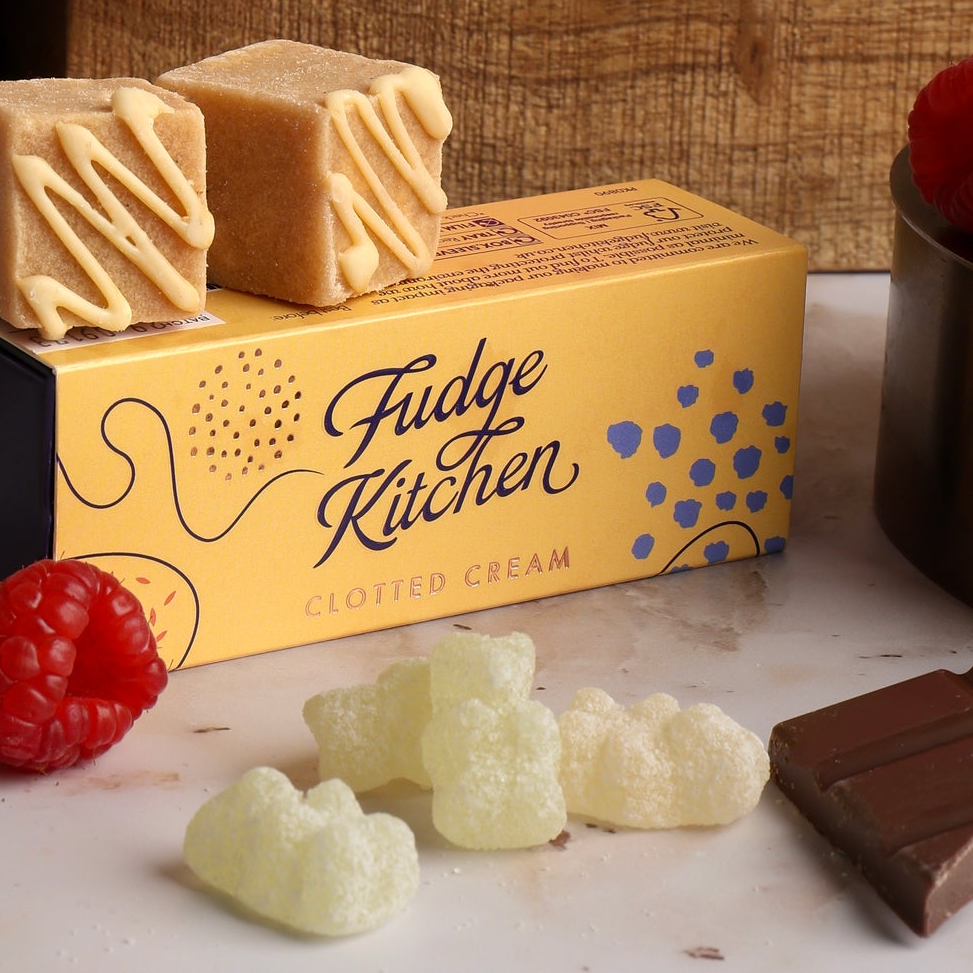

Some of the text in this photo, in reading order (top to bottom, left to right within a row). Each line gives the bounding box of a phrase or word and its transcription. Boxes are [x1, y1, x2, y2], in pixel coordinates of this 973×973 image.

[682, 226, 733, 240] protect
[613, 236, 655, 251] fudge
[656, 236, 681, 244] our
[685, 233, 746, 247] minimal
[705, 242, 731, 251] are
[732, 239, 759, 247] We
[566, 246, 613, 259] whilst
[629, 247, 705, 265] committed
[489, 253, 566, 272] protecting
[548, 258, 580, 270] find
[552, 261, 611, 275] making
[464, 267, 491, 276] the
[481, 269, 522, 280] more
[522, 265, 548, 274] out
[527, 271, 553, 280] our
[402, 283, 437, 293] how
[436, 276, 481, 287] about
[444, 274, 525, 293] packaging
[390, 288, 447, 303] impact
[323, 338, 548, 469] Fudge
[313, 416, 580, 570] Kitchen
[305, 547, 571, 618] CLOTTED CREAM
